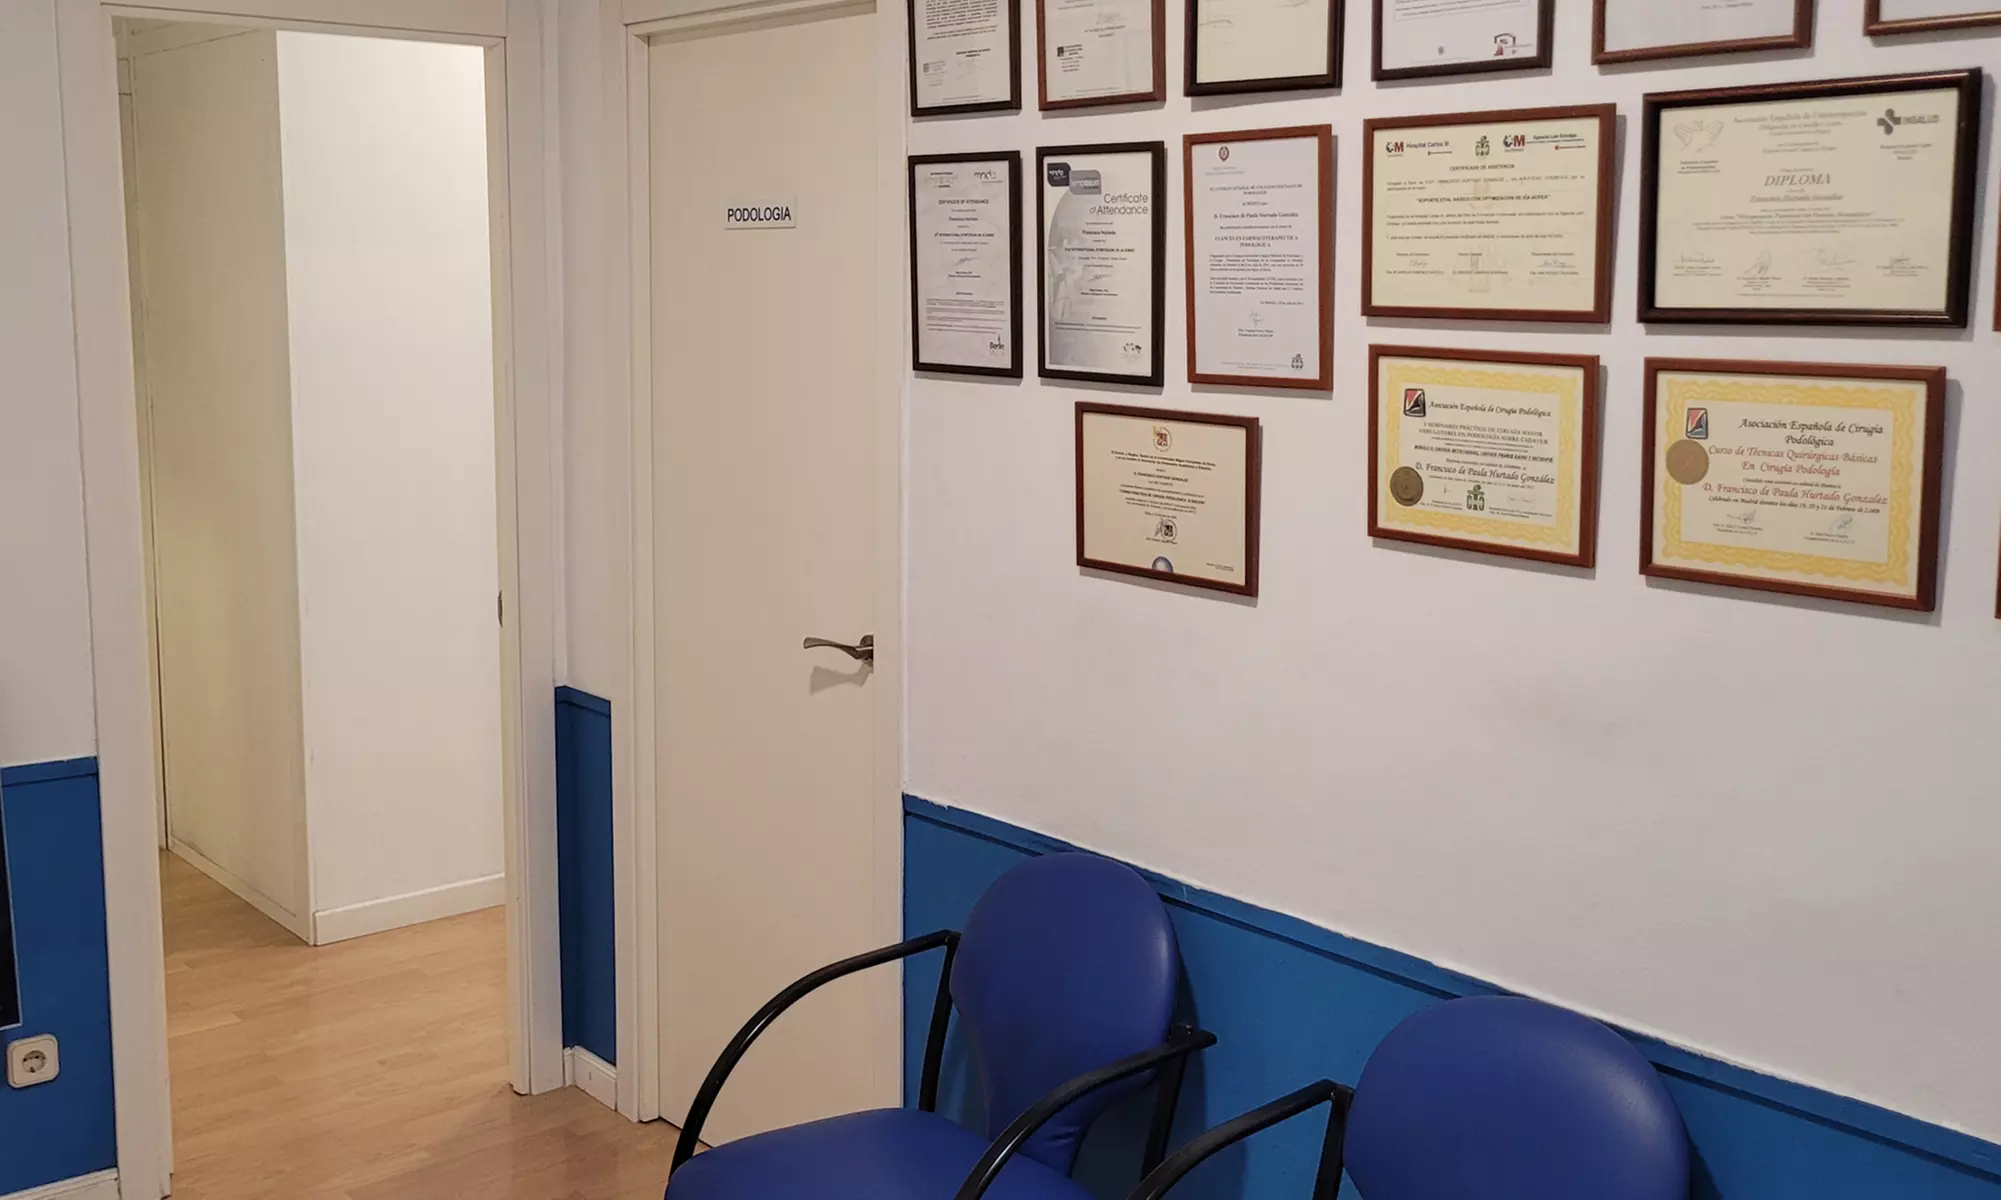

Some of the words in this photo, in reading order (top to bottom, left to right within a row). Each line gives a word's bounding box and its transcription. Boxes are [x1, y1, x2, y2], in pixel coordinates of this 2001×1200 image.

[1764, 173, 1831, 187] DIPLOMA
[1103, 193, 1149, 203] Certificate
[727, 206, 792, 222] PODOLOGIA
[1097, 205, 1149, 215] Attendance
[1738, 418, 1788, 429] Asociación
[1789, 420, 1833, 433] Española
[1834, 421, 1846, 432] de
[1848, 423, 1884, 437] Cirugía
[1784, 435, 1835, 449] Podológica
[1708, 444, 1733, 455] Curso
[1734, 445, 1745, 456] de
[1746, 446, 1785, 458] Técnicas
[1786, 448, 1840, 463] Quirúrgicas
[1841, 451, 1879, 463] Básicas
[1426, 463, 1457, 473] Francisco
[1457, 465, 1466, 474] de
[1467, 467, 1488, 477] Paula
[1489, 469, 1519, 480] Hurtado
[1741, 460, 1755, 470] En
[1760, 461, 1793, 475] Cirugía
[1796, 464, 1841, 478] Podología
[1702, 482, 1713, 492] D.
[1716, 483, 1758, 495] Francisco
[1759, 484, 1770, 496] de
[1771, 486, 1799, 498] Paula
[1800, 488, 1841, 501] Hurtado
